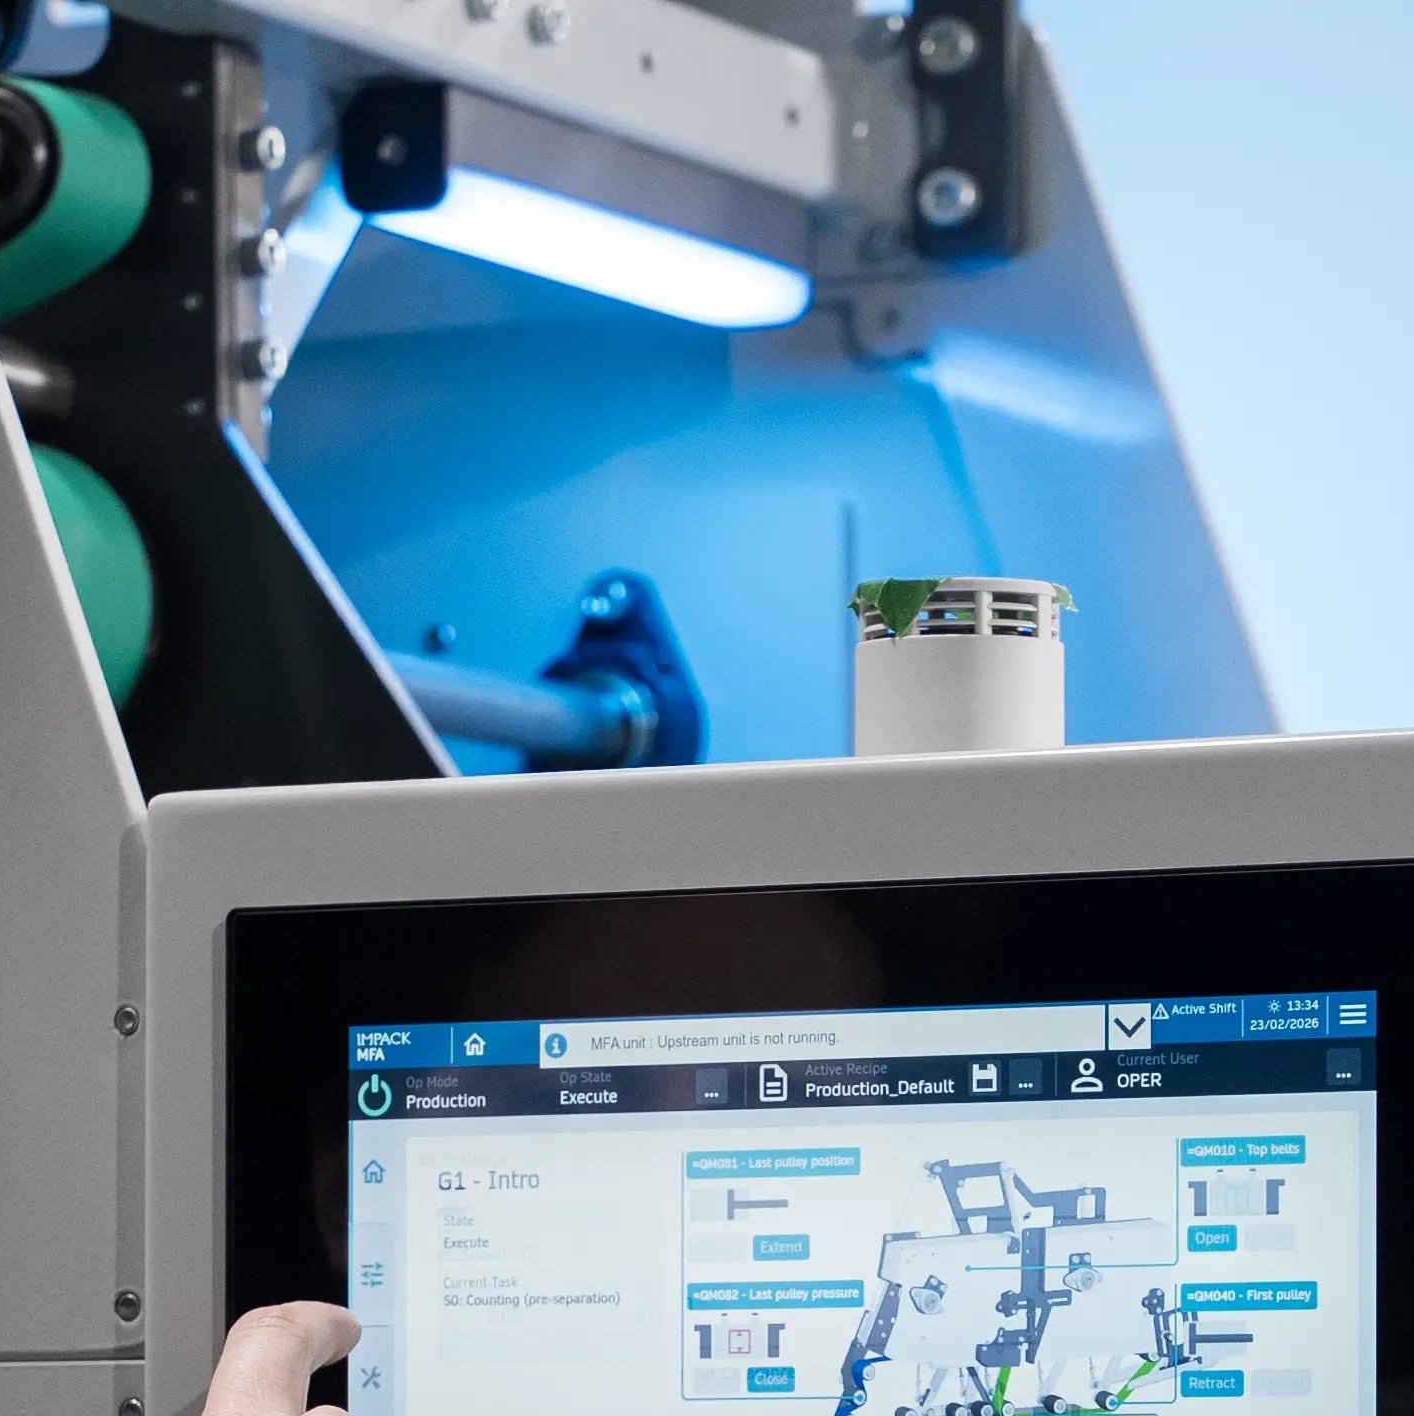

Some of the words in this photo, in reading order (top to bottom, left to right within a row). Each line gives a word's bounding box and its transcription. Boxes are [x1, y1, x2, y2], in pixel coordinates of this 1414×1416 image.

[1171, 1003, 1207, 1016] Active
[1209, 1002, 1237, 1015] Shift
[1286, 999, 1320, 1012] 13:34
[1249, 1017, 1320, 1031] 23/02/2026
[355, 1031, 412, 1047] IMPACK
[590, 1035, 621, 1051] MFA
[622, 1035, 647, 1050] unit
[657, 1034, 719, 1051] Upstream
[722, 1033, 747, 1047] unit
[749, 1032, 761, 1046] is
[764, 1032, 785, 1046] not
[787, 1030, 840, 1047] running.
[355, 1047, 386, 1062] MFA
[1116, 1053, 1167, 1067] Current
[1169, 1052, 1201, 1066] User
[559, 1071, 577, 1086] Op
[580, 1070, 613, 1084] State
[804, 1063, 843, 1078] Active
[846, 1062, 888, 1076] Recipe
[405, 1076, 424, 1091] Op
[426, 1075, 460, 1089] Mode
[1116, 1072, 1163, 1089] OPER
[805, 1079, 956, 1099] Production_Default
[405, 1093, 487, 1110] Production
[559, 1089, 619, 1106] Execute
[1246, 1143, 1268, 1158] Top
[1270, 1142, 1300, 1155] belts
[748, 1156, 772, 1169] Last
[774, 1156, 808, 1171] pulley
[810, 1155, 855, 1169] position
[437, 1170, 467, 1192] G1
[487, 1169, 541, 1191] Intro
[442, 1214, 475, 1228] State
[442, 1236, 490, 1250] Execute
[1194, 1230, 1230, 1246] Open
[759, 1240, 803, 1254] Extend
[442, 1276, 488, 1290] Current
[491, 1275, 519, 1289] Task
[465, 1293, 521, 1308] Counting
[523, 1291, 622, 1308] (pre-separation)
[748, 1287, 773, 1301] Last
[775, 1287, 809, 1302] pulley
[810, 1286, 860, 1302] pressure
[1246, 1288, 1274, 1301] First
[1276, 1288, 1312, 1303] pulley
[753, 1372, 789, 1386] Close
[1188, 1376, 1237, 1390] Retract
